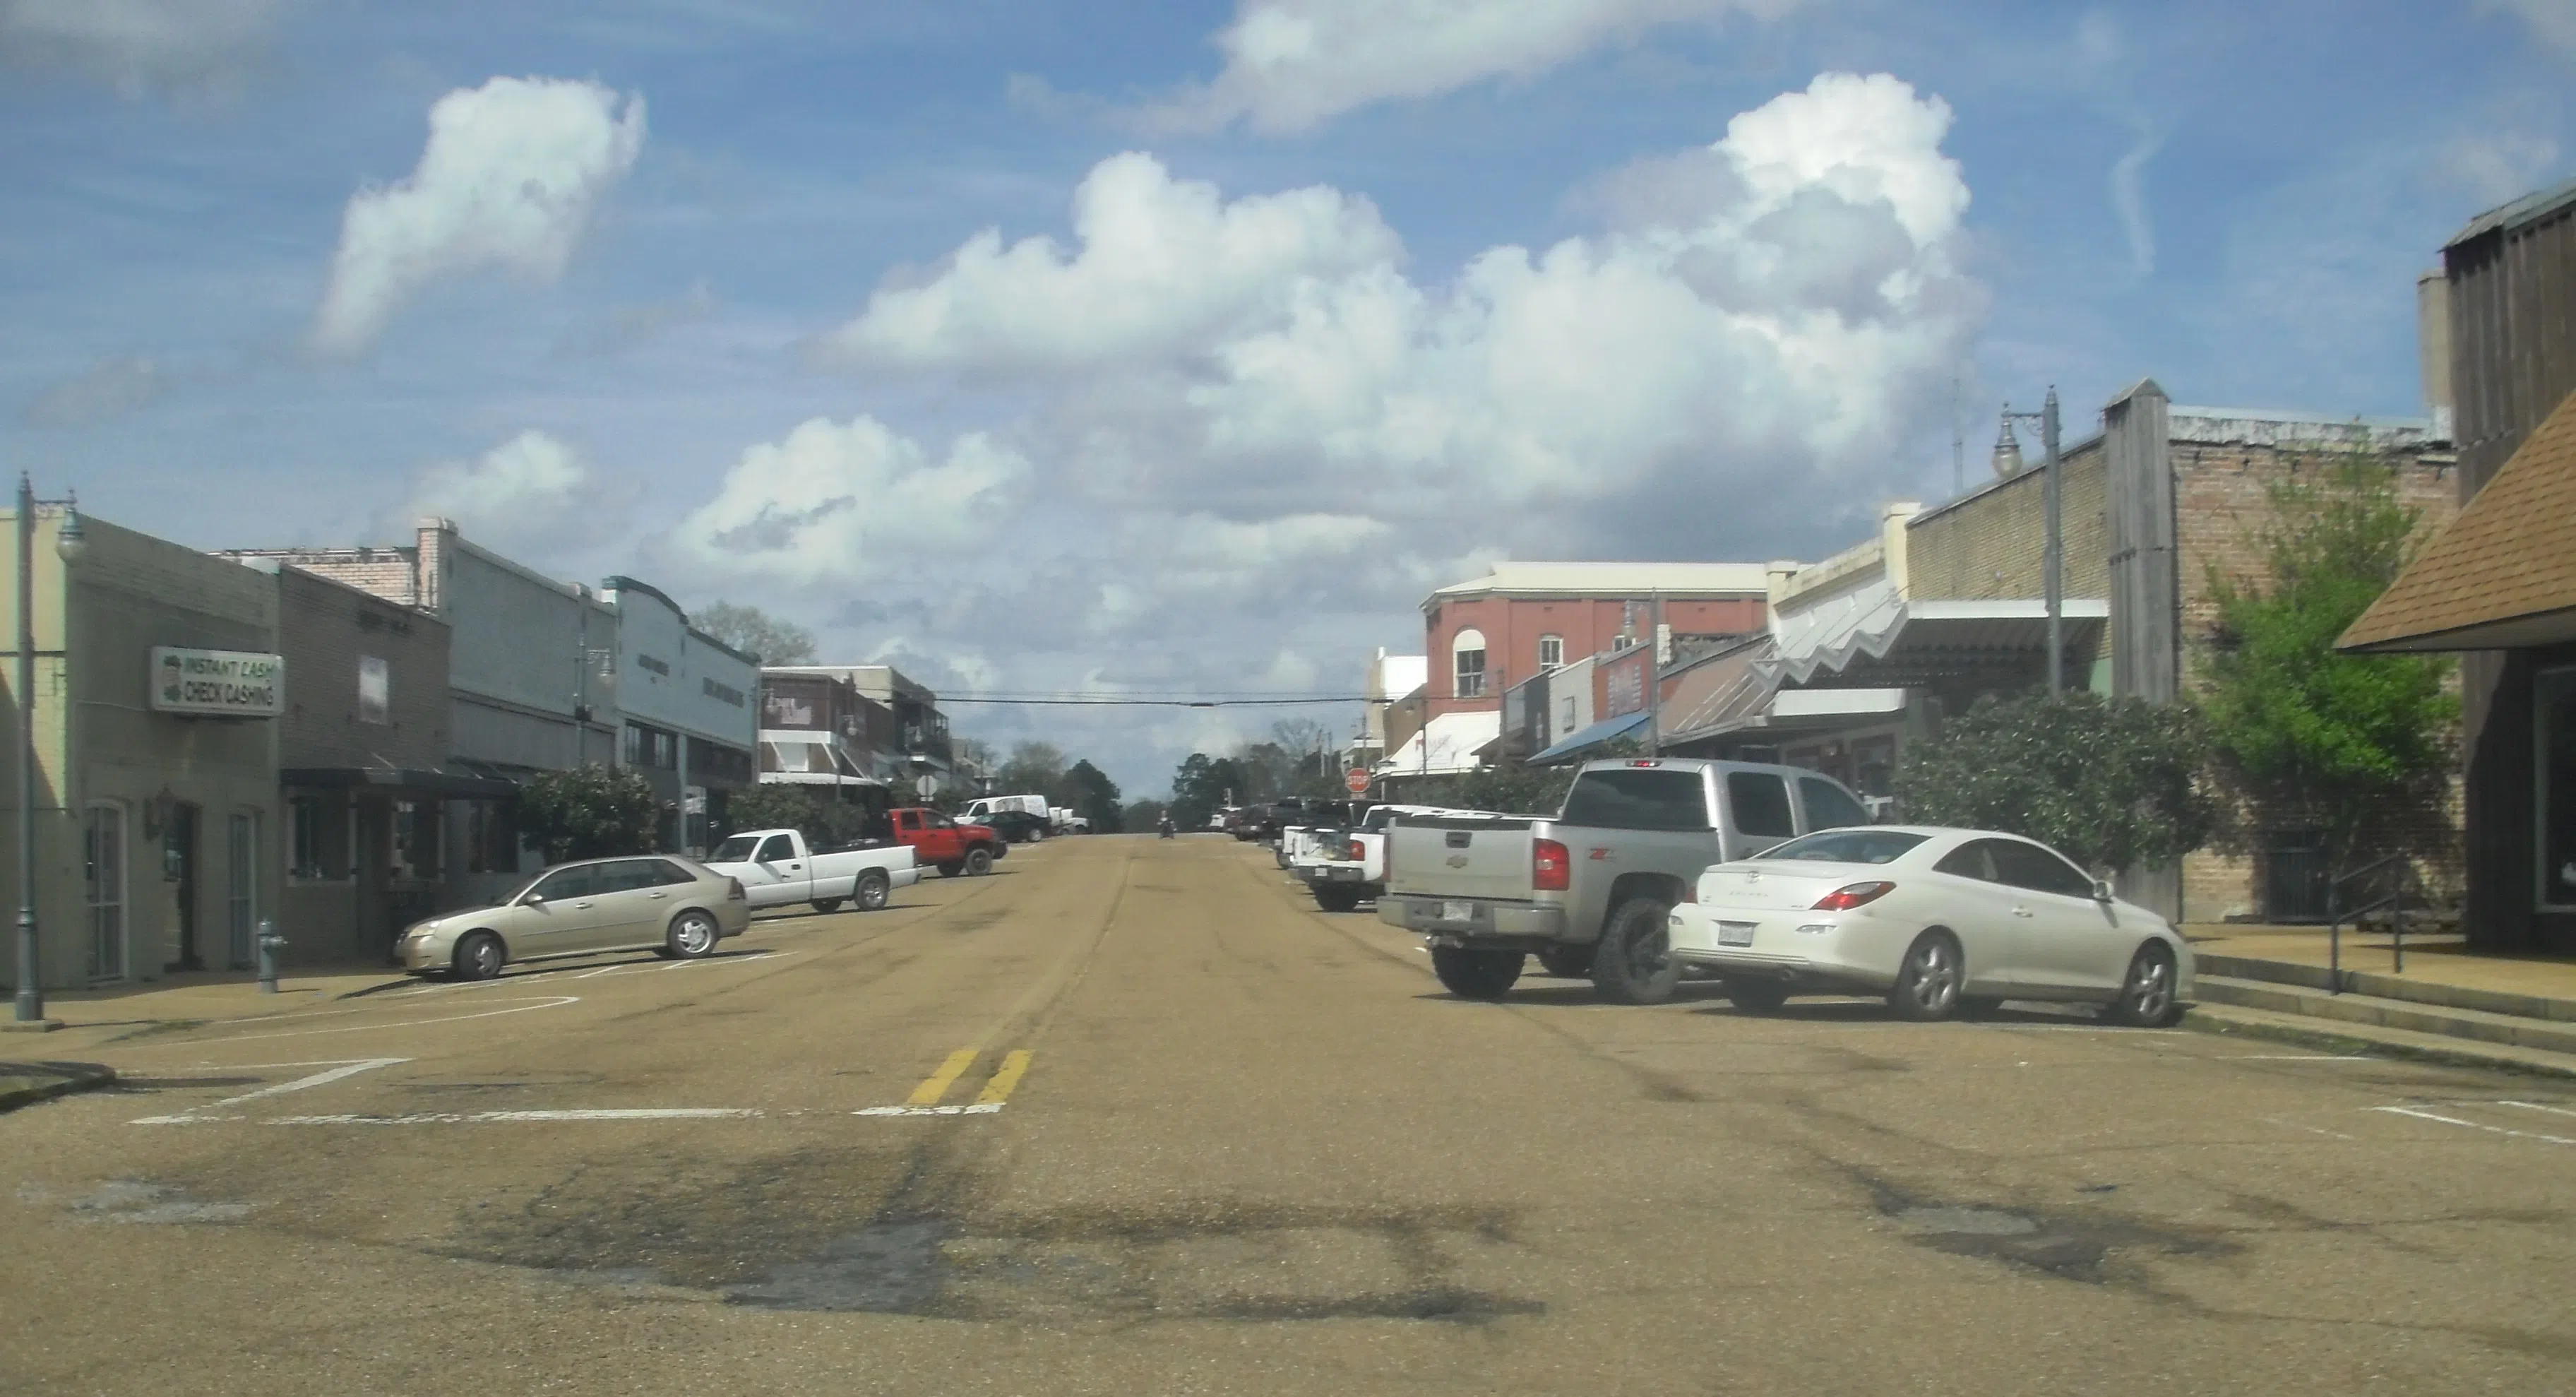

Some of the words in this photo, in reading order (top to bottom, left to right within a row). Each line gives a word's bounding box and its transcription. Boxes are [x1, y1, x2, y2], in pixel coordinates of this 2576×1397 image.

[185, 657, 238, 675] INSTANT
[241, 661, 275, 678] CASH
[185, 680, 224, 703] CHECK
[225, 683, 275, 706] CASHING
[1348, 775, 1368, 785] STOP
